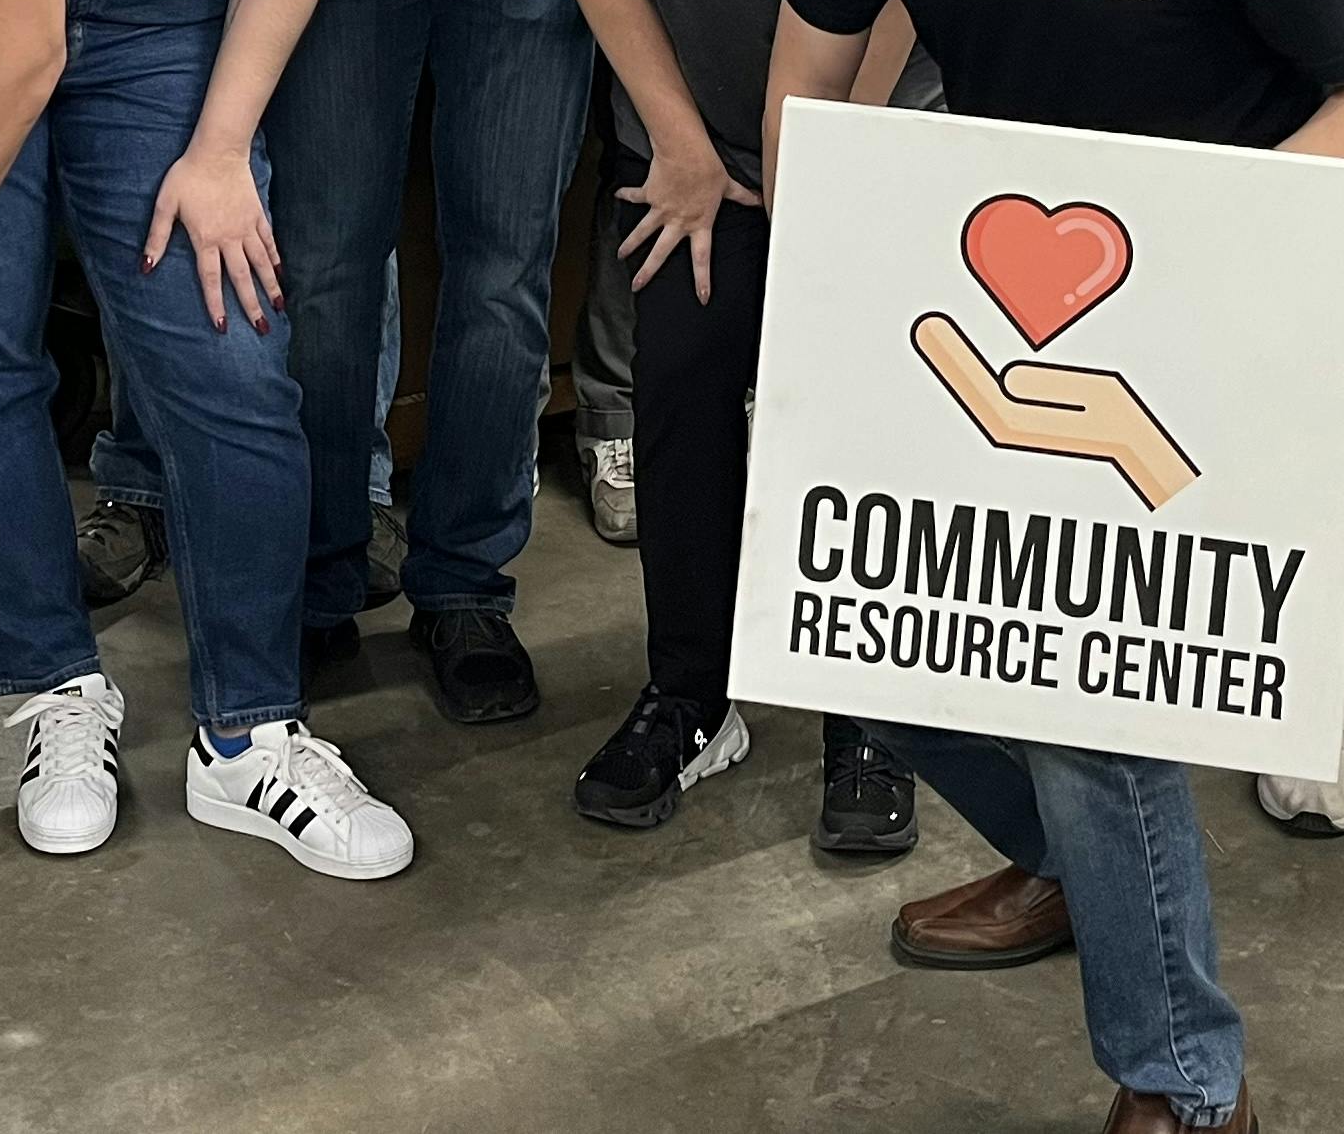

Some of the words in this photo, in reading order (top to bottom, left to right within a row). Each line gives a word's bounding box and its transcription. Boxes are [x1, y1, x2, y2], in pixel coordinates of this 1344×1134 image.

[797, 485, 1307, 645] COMMUNITY
[788, 590, 1064, 689] RESOURCE
[1078, 630, 1288, 721] CENTER
